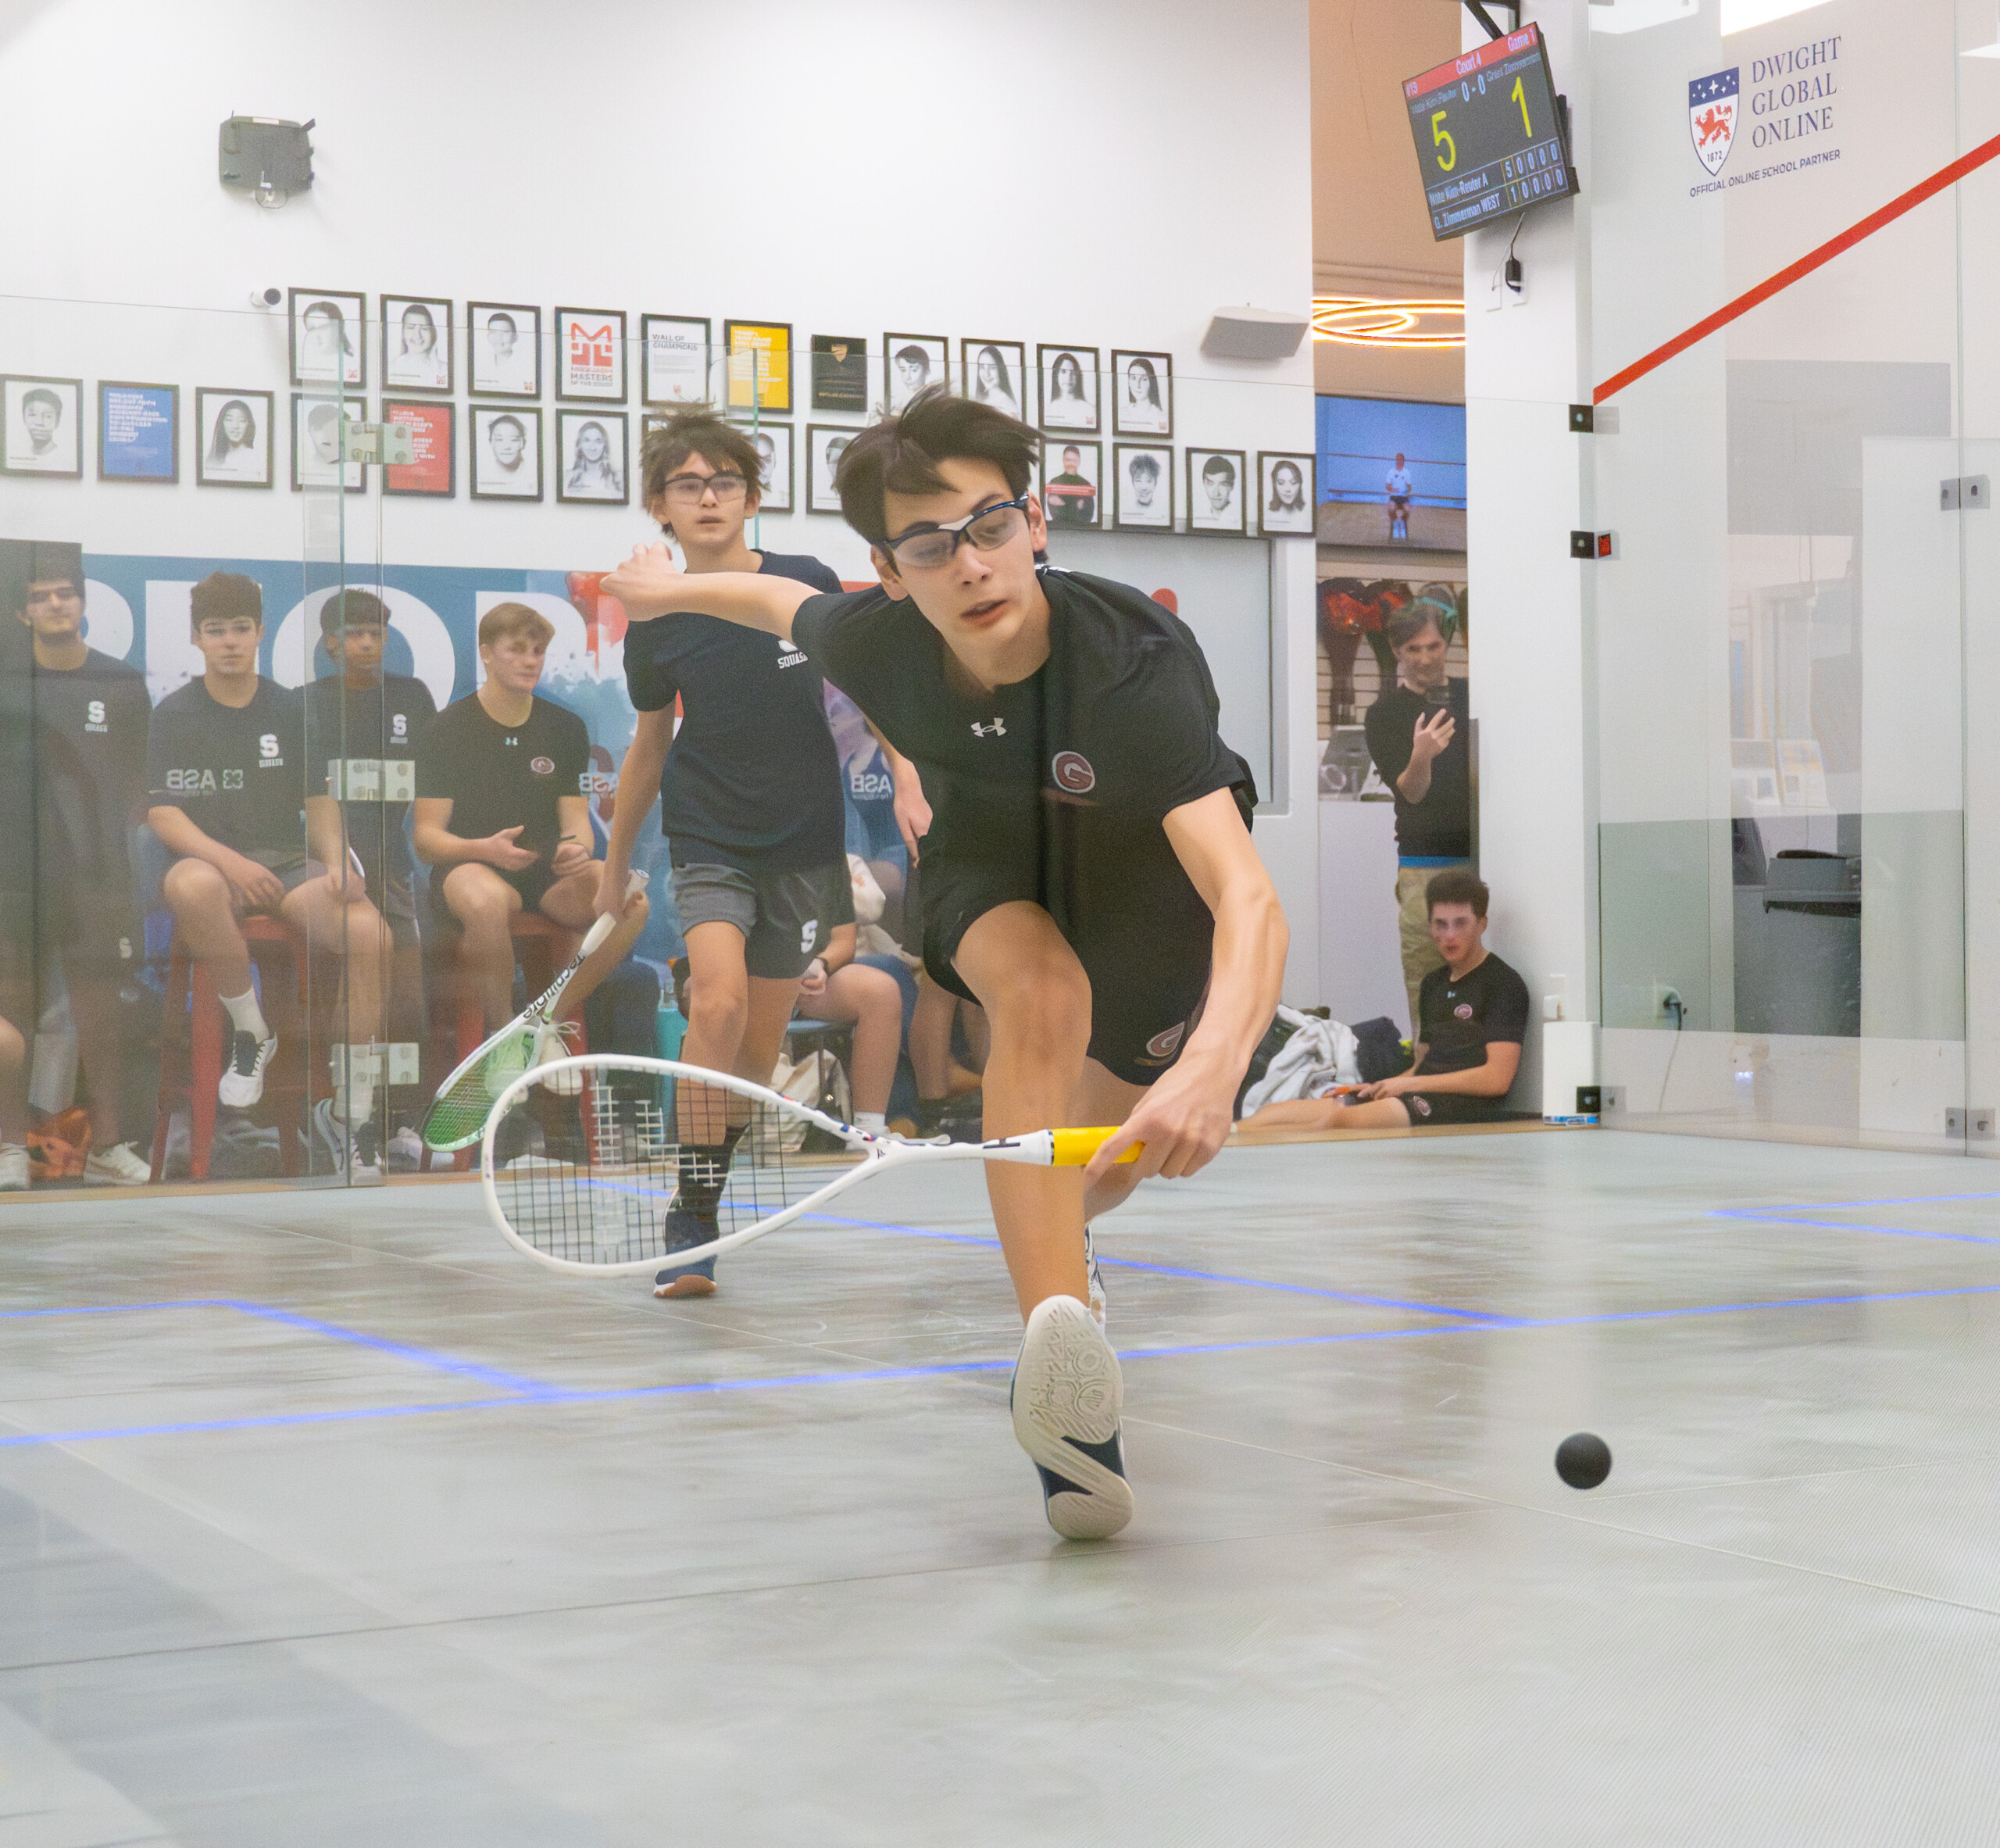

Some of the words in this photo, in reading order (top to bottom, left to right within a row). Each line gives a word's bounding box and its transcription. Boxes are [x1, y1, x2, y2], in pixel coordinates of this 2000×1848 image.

[1507, 33, 1530, 52] Game
[1752, 36, 1841, 84] DWIGHT
[1456, 55, 1477, 76] Court
[1476, 52, 1481, 67] 4
[1461, 81, 1470, 102] 0
[1478, 74, 1486, 95] 0
[1752, 73, 1838, 116] GLOBAL
[1512, 77, 1532, 138] 1
[1431, 110, 1455, 171] 5
[1752, 106, 1834, 148] ONLINE
[1482, 173, 1488, 187] A
[1505, 161, 1512, 178] 5
[1516, 157, 1523, 174] 0
[1527, 152, 1535, 170] 0
[1539, 148, 1546, 166] 0
[1551, 143, 1558, 161] 0
[1689, 179, 1727, 198] OFFICIAL
[1728, 170, 1760, 188] ONLINE
[1762, 161, 1798, 178] SCHOOL
[1799, 149, 1841, 169] PARTNER
[1707, 151, 1723, 163] 1872
[1443, 203, 1481, 227] Zimmerman
[1480, 192, 1500, 213] WEST
[1510, 185, 1517, 202] 1
[1521, 181, 1529, 199] 0
[1533, 177, 1540, 195] 0
[1544, 173, 1552, 191] 0
[1555, 168, 1563, 186] 0
[571, 373, 612, 381] MASTERS
[88, 700, 105, 724] S
[392, 713, 407, 735] S
[259, 733, 280, 758] S
[1052, 751, 1095, 794] G
[801, 919, 818, 954] S
